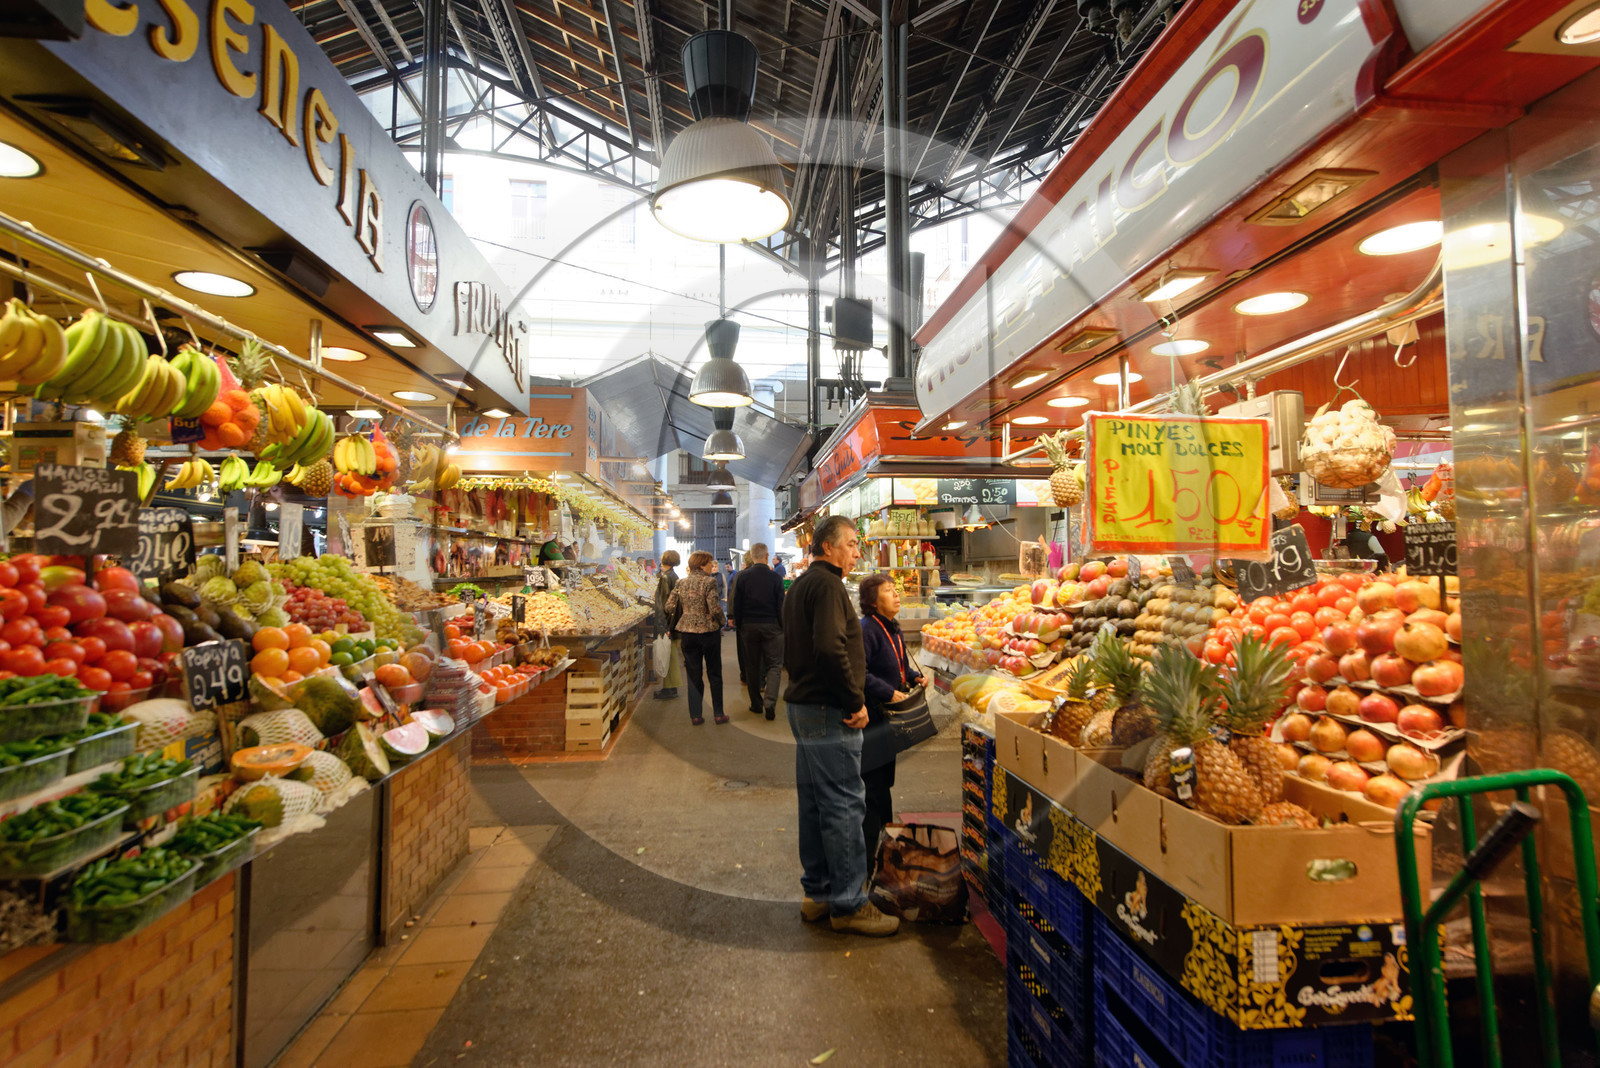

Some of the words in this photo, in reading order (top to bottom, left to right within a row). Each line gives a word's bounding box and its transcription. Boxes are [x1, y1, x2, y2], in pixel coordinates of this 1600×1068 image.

[460, 416, 489, 437] de
[493, 416, 515, 438] la
[522, 416, 573, 439] Tere
[1107, 420, 1195, 441] PINYES
[1121, 441, 1164, 456] MOLT
[1175, 440, 1244, 457] DOLCES
